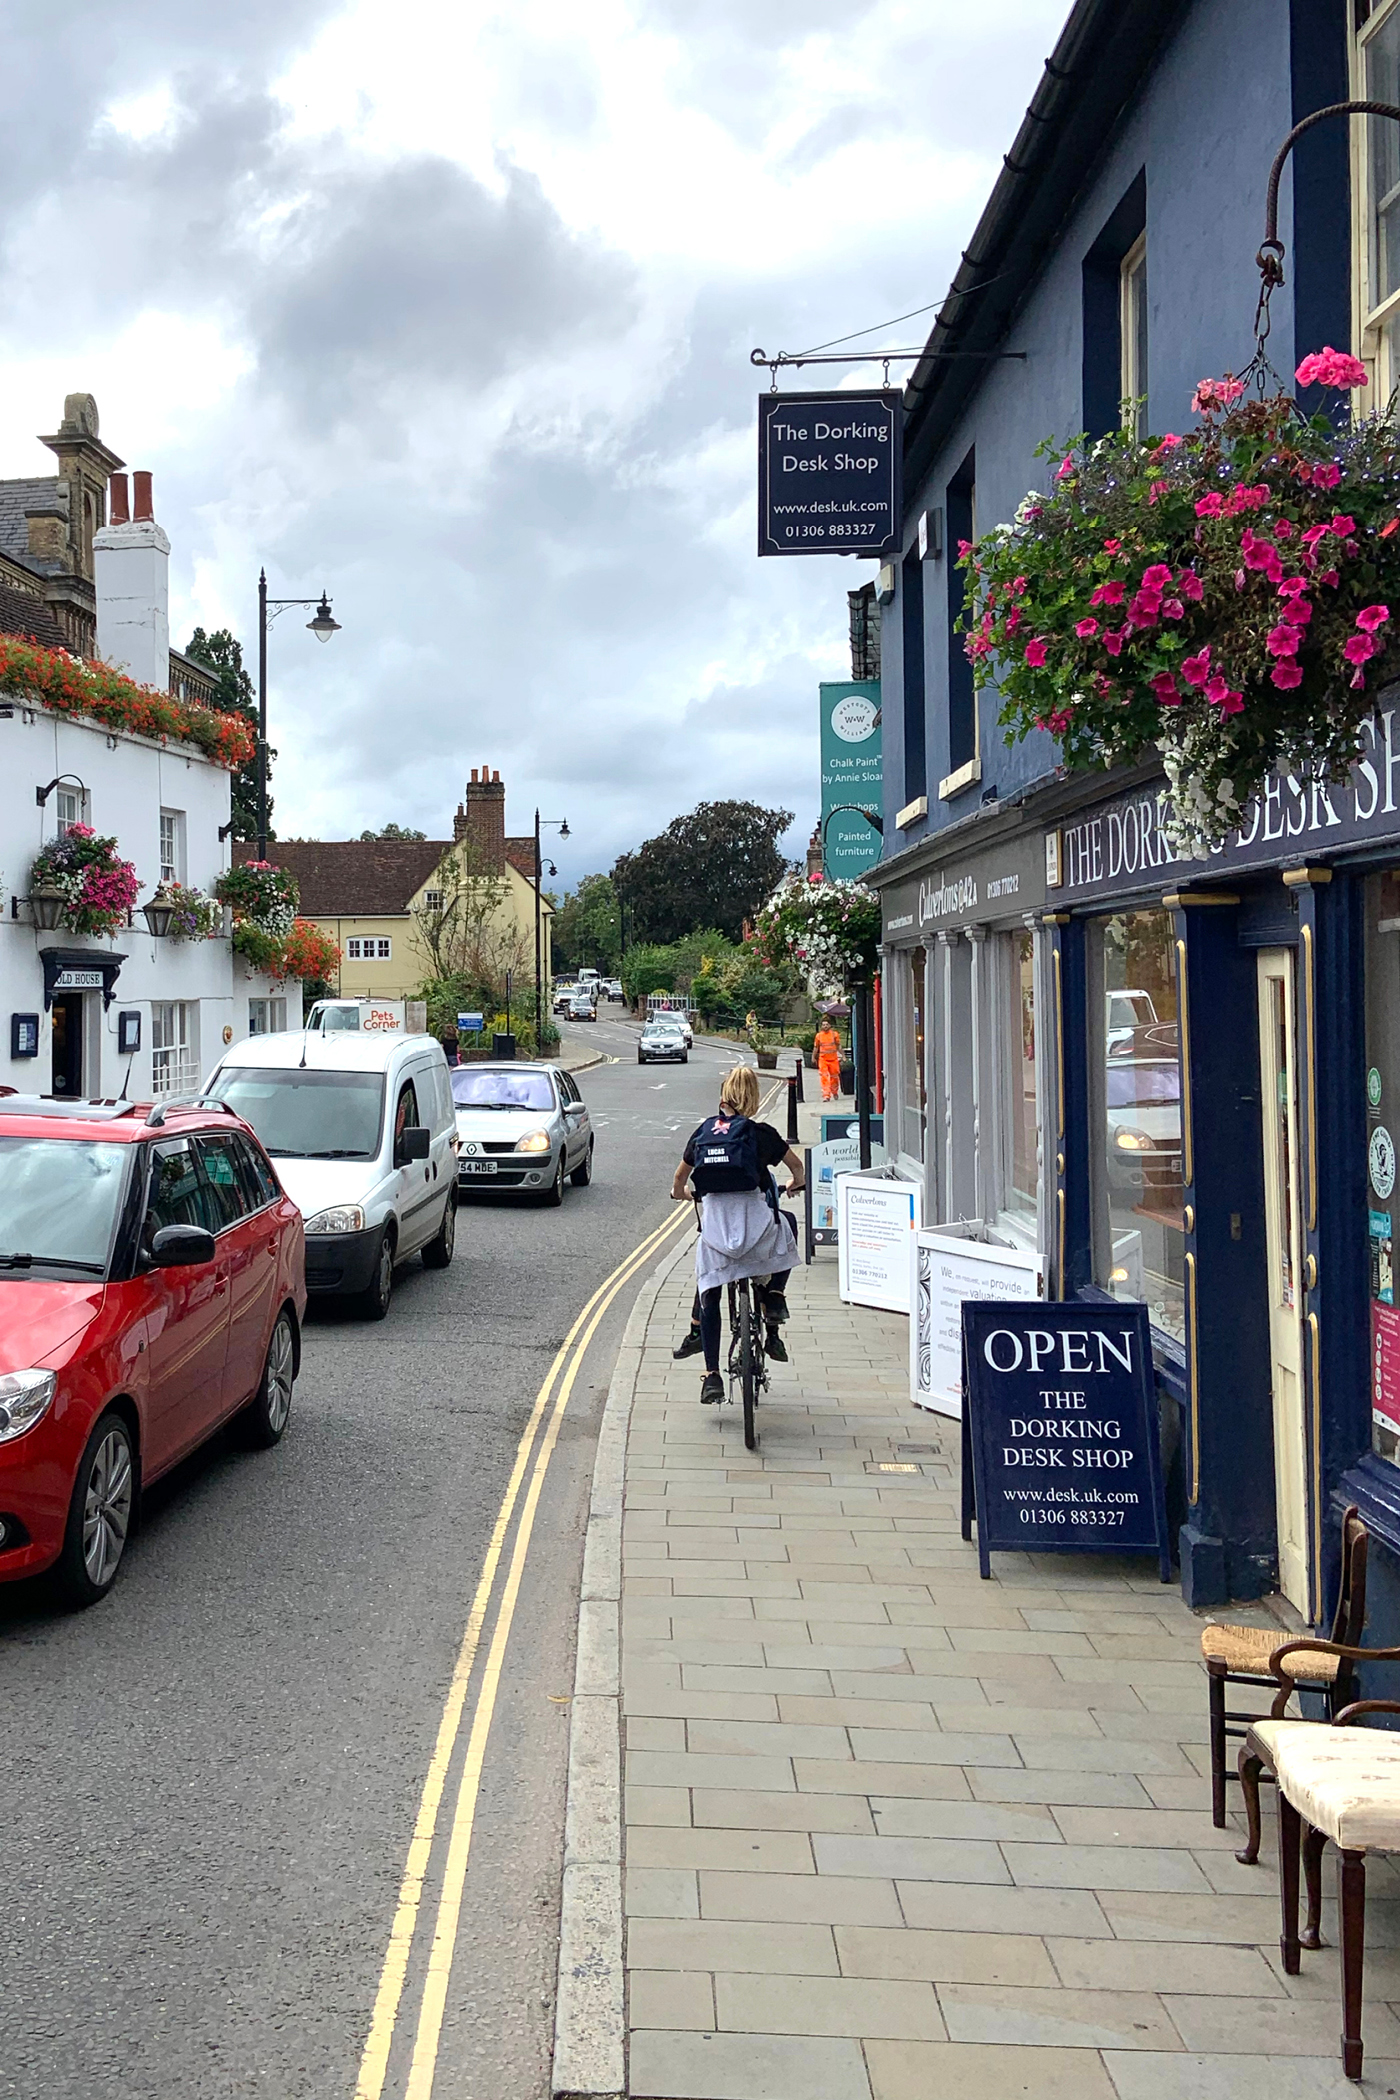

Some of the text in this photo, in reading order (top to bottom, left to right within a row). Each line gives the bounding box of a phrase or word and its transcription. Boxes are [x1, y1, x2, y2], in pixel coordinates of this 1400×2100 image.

[773, 422, 889, 442] The Dorking
[782, 453, 879, 473] Desk Shop
[773, 500, 888, 513] www.desk.uk.com
[785, 523, 876, 537] 01306 883327
[830, 758, 854, 768] Chalk
[822, 775, 832, 785] by
[834, 773, 860, 782] Annie
[838, 831, 871, 841] Painted
[835, 847, 874, 856] furniture
[1065, 818, 1104, 888] THE
[75, 973, 100, 984] HOUSE
[371, 1010, 394, 1022] Pets
[363, 1018, 401, 1030] Corner
[832, 1144, 858, 1156] world
[990, 1279, 1022, 1294] provide
[983, 1329, 1134, 1373] OPEN
[1039, 1391, 1087, 1410] THE
[1010, 1419, 1121, 1439] DORKING
[1002, 1447, 1134, 1469] DESK SHOP
[1003, 1488, 1140, 1504] www.desk.uk.com
[1020, 1508, 1125, 1526] 01306 883327
